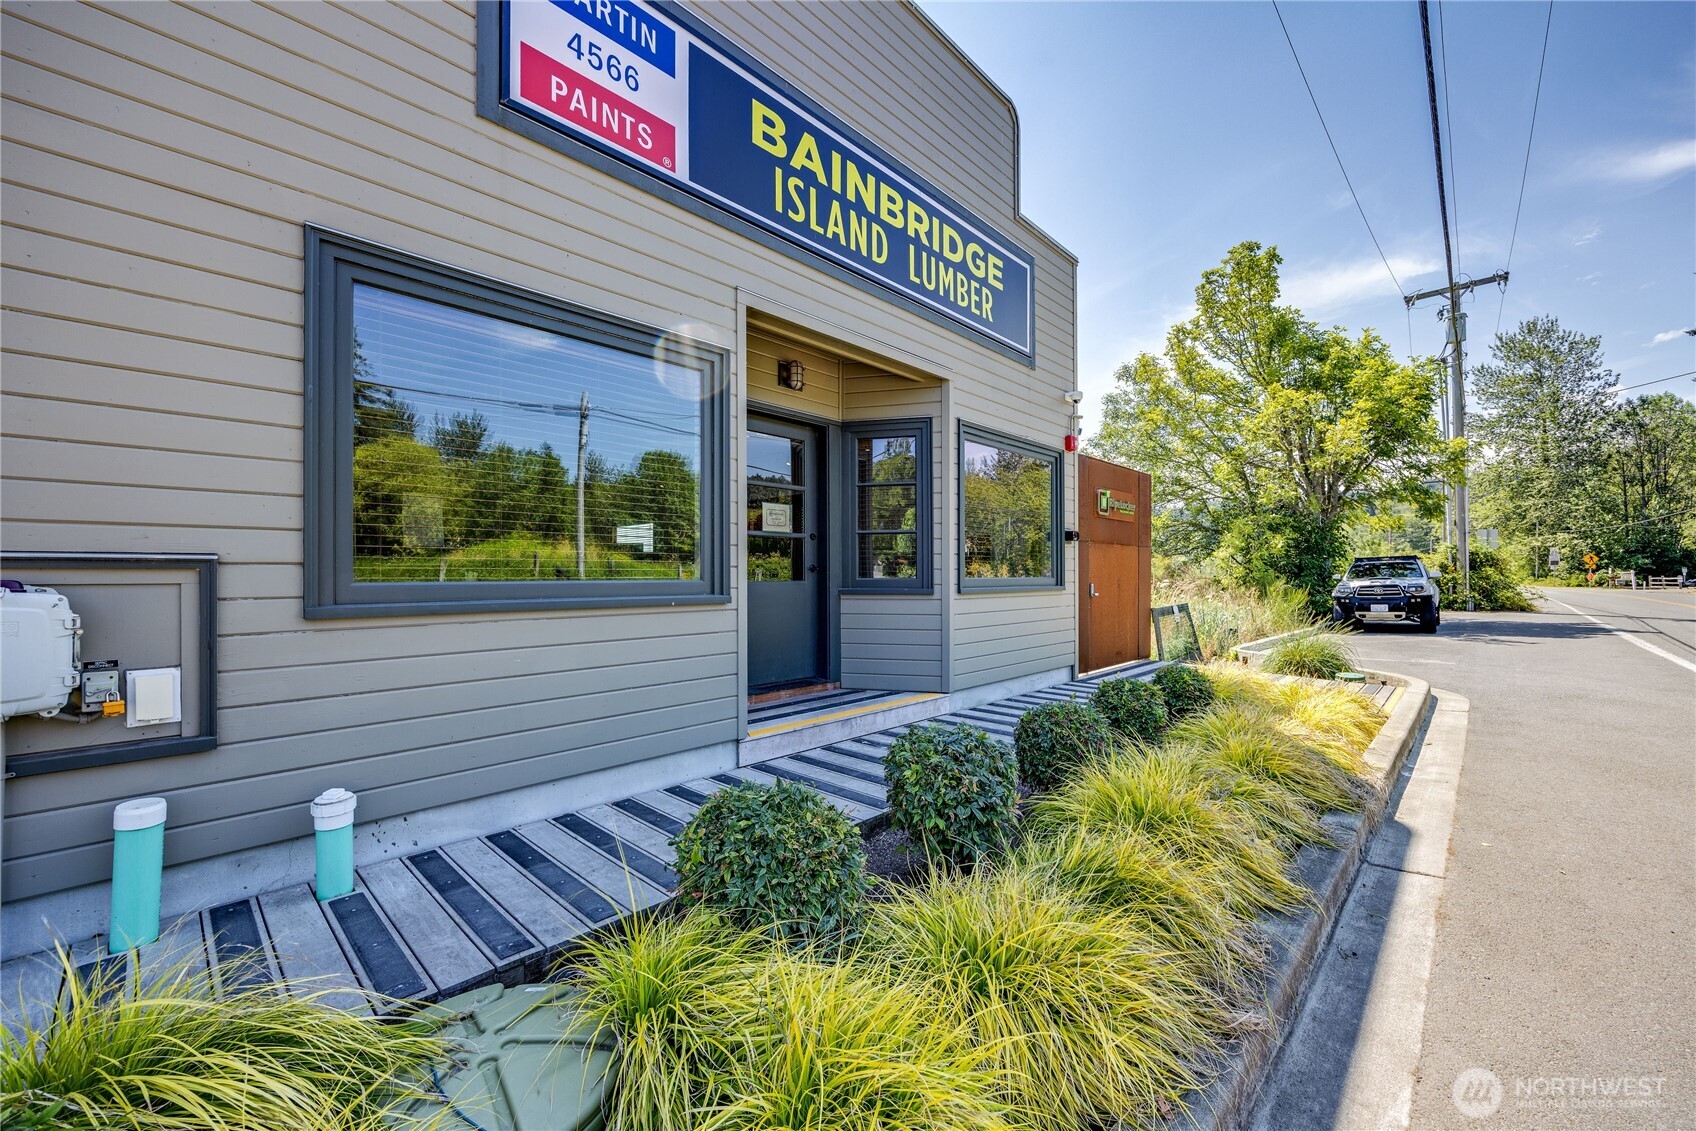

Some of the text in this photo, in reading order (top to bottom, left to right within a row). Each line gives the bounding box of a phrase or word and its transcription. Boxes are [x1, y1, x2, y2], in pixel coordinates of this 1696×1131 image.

[551, 74, 653, 150] PAINTS
[567, 33, 639, 92] 4566
[752, 98, 1004, 291] BAINBRIDGE
[775, 166, 994, 323] ISLAND LUMBER
